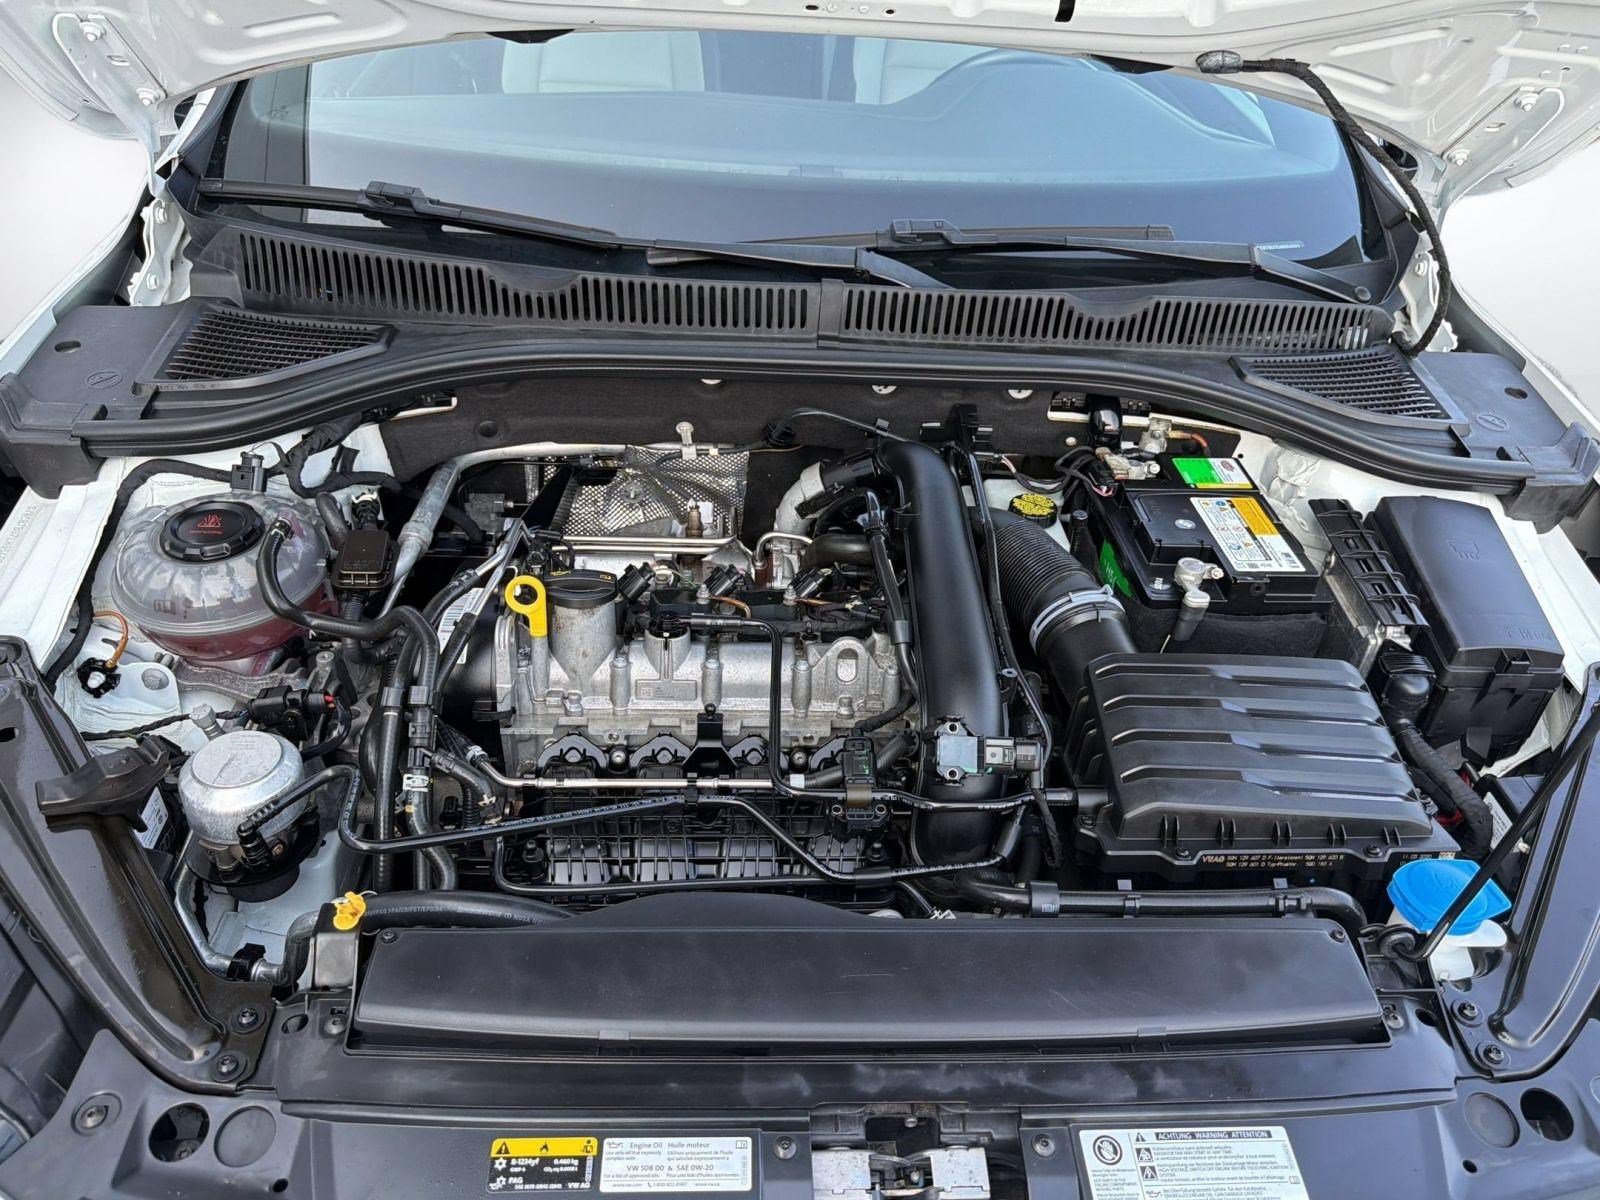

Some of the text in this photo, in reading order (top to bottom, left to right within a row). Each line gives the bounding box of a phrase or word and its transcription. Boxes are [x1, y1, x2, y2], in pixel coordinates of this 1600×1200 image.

[1158, 1132, 1192, 1140] ACHTUNG
[629, 1141, 663, 1150] Engine Oil
[667, 1141, 686, 1149] Huile
